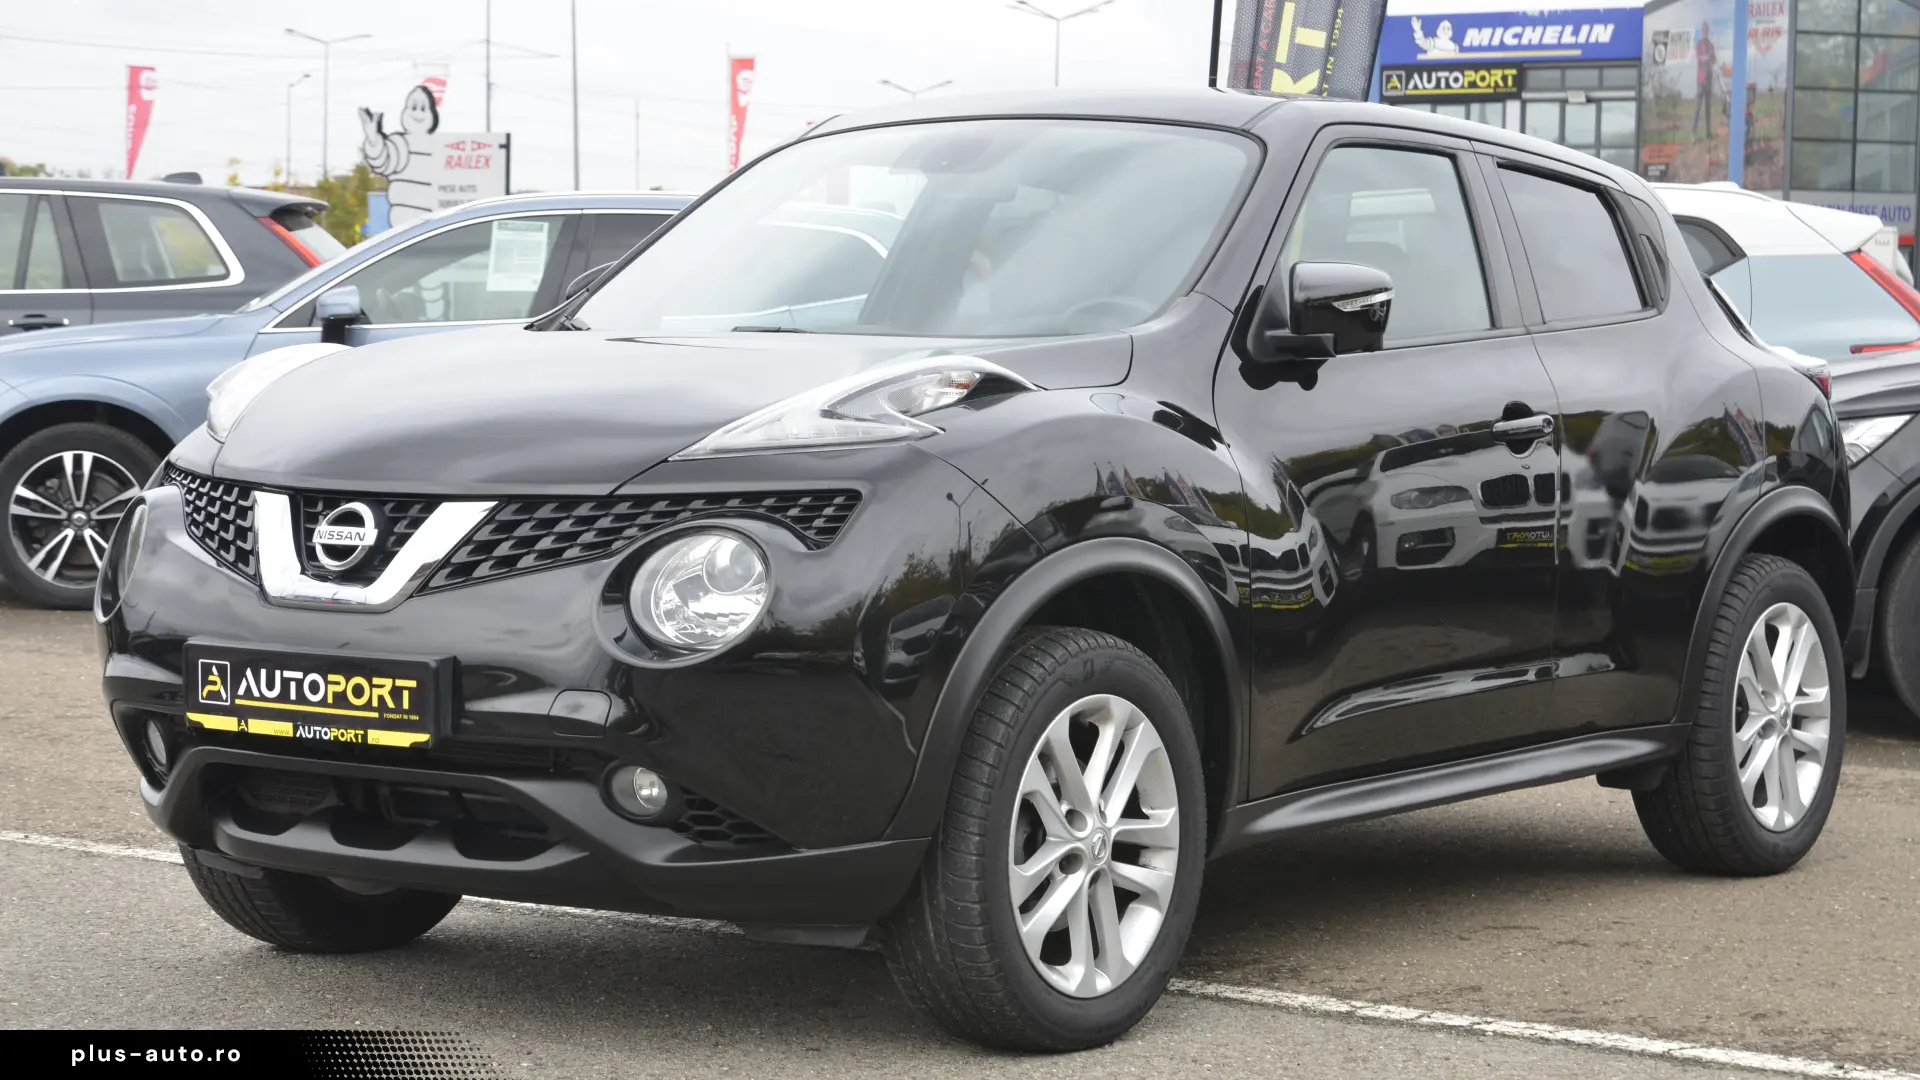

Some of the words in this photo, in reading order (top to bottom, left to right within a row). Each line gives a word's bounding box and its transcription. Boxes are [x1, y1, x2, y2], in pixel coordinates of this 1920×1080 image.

[1325, 56, 1335, 75] IN
[1330, 8, 1345, 48] 1994
[1463, 23, 1615, 47] MICHELIN
[1407, 68, 1518, 90] AUTOPORT
[444, 155, 492, 169] RAILEX
[1880, 204, 1911, 222] AUTO
[315, 529, 366, 542] NISSAN
[237, 667, 417, 710] AUTOPORT
[273, 728, 292, 737] www.
[296, 725, 364, 743] AUTOPORT
